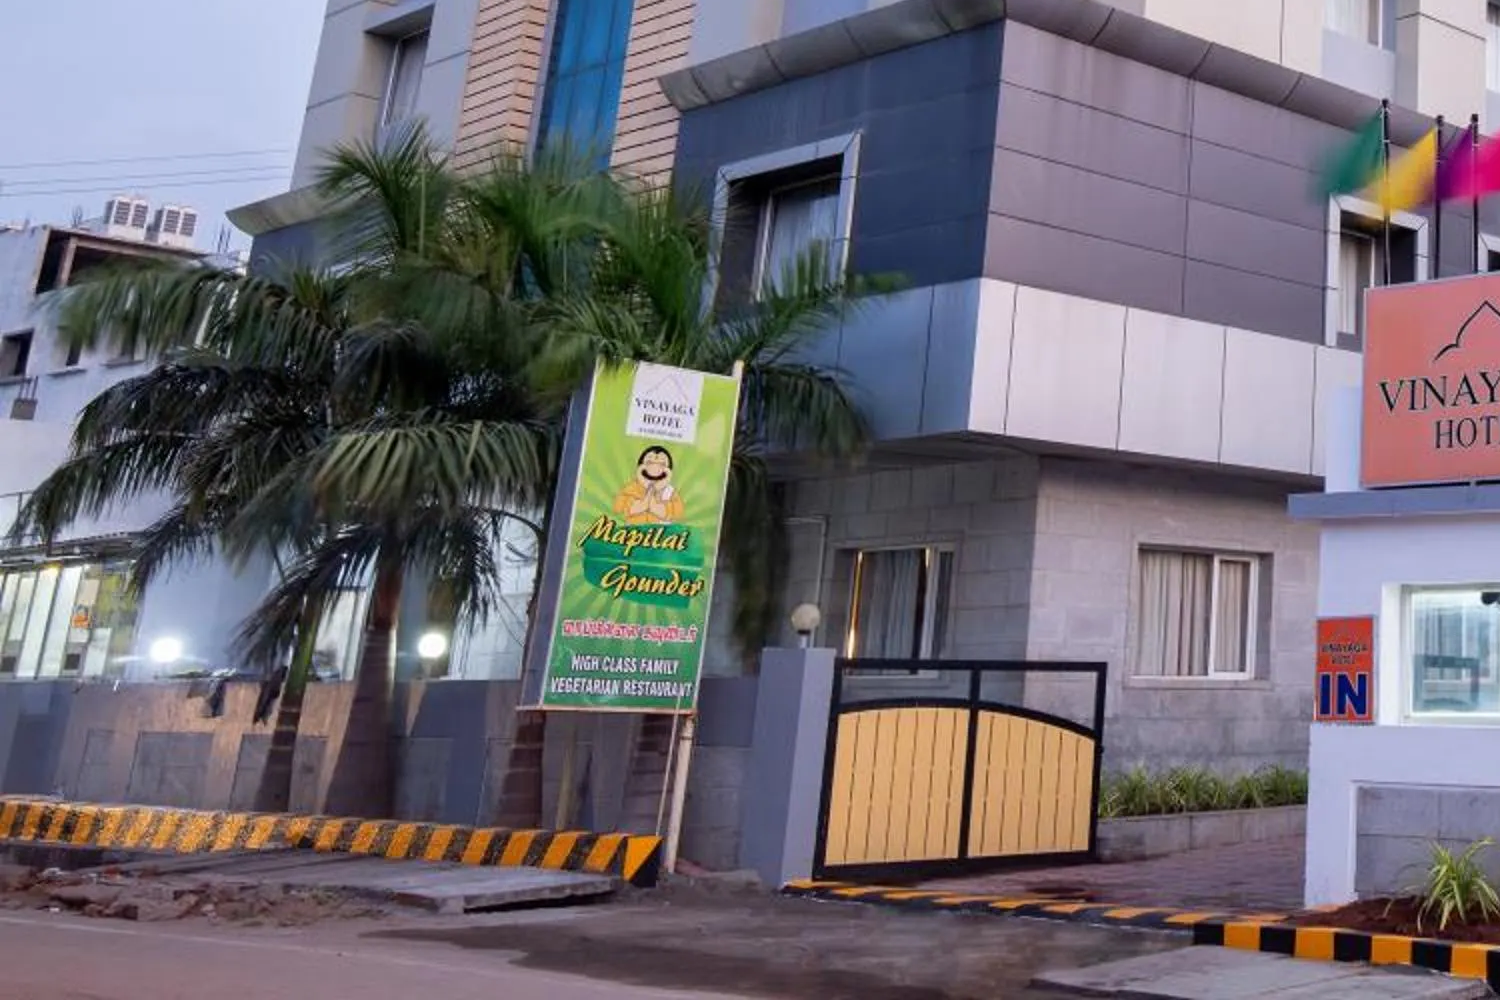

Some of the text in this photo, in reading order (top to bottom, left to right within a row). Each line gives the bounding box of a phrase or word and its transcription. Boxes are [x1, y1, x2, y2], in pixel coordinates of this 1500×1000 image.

[577, 514, 690, 557] Mapilai
[601, 564, 704, 599] Gounder
[571, 655, 680, 675] HIGH CLASS FAMILY
[551, 676, 694, 698] VEGETARIAN RESTAURANT
[1319, 672, 1368, 716] IN
